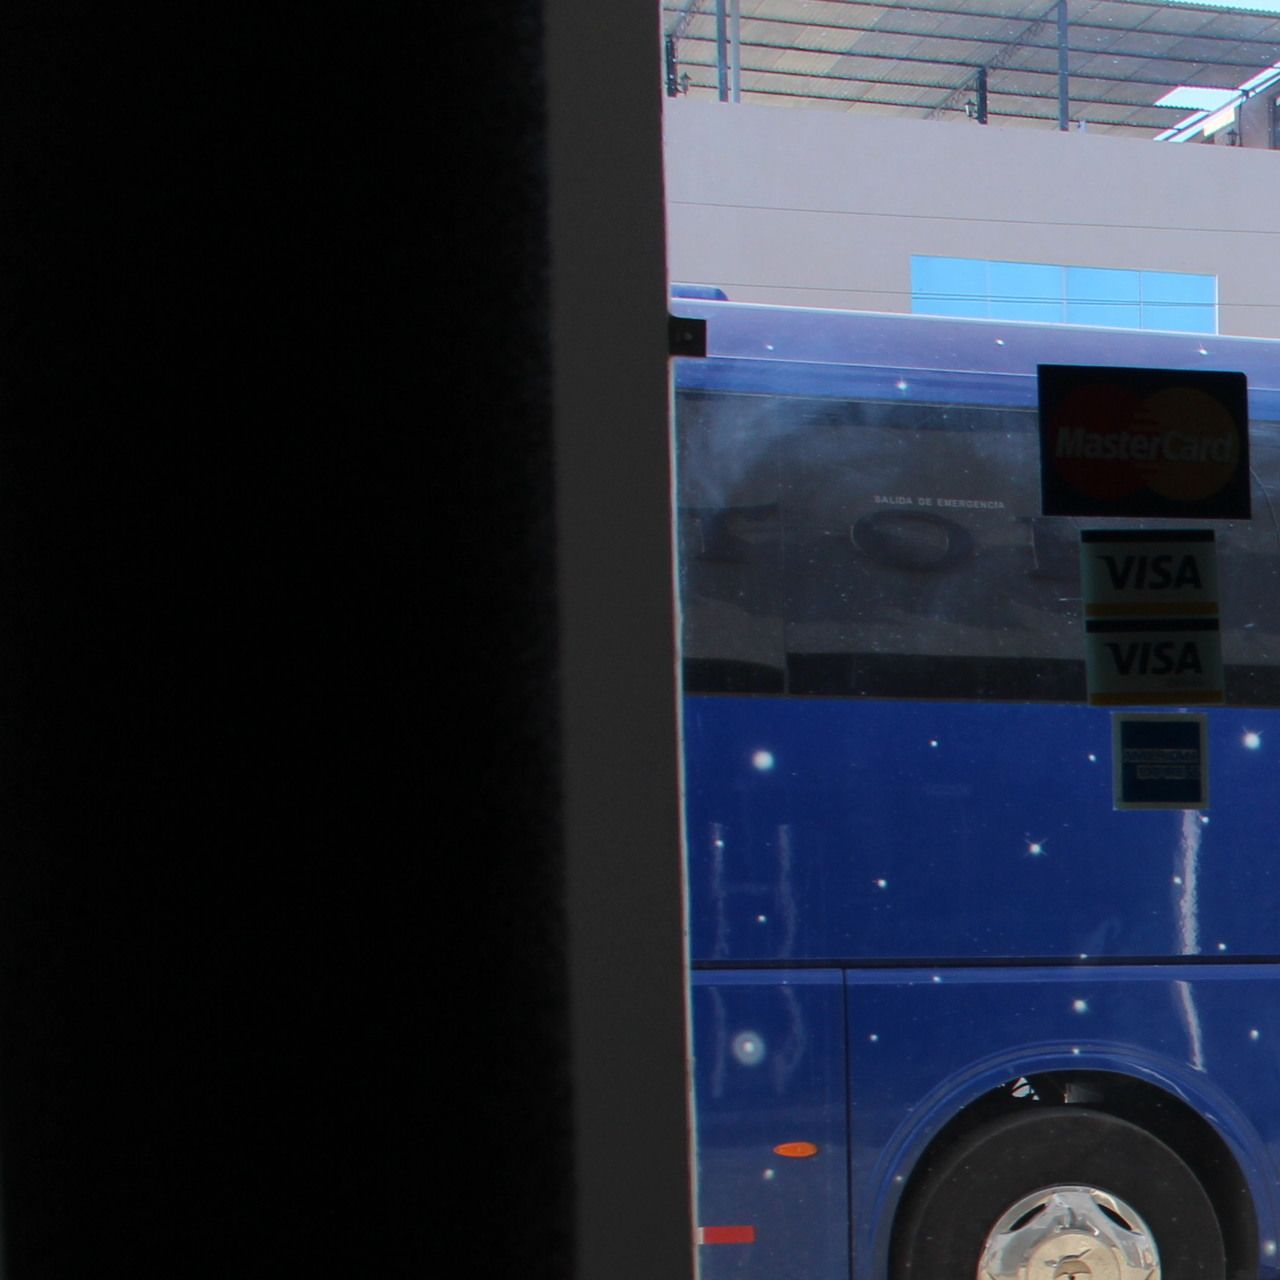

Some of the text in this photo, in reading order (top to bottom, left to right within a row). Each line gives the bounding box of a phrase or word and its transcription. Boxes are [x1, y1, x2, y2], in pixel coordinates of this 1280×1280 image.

[1055, 425, 1232, 465] MasterCard
[874, 495, 1005, 509] SALIDA DE EMERGENCIA
[1096, 553, 1203, 591] VISA
[1104, 640, 1203, 676] VISA
